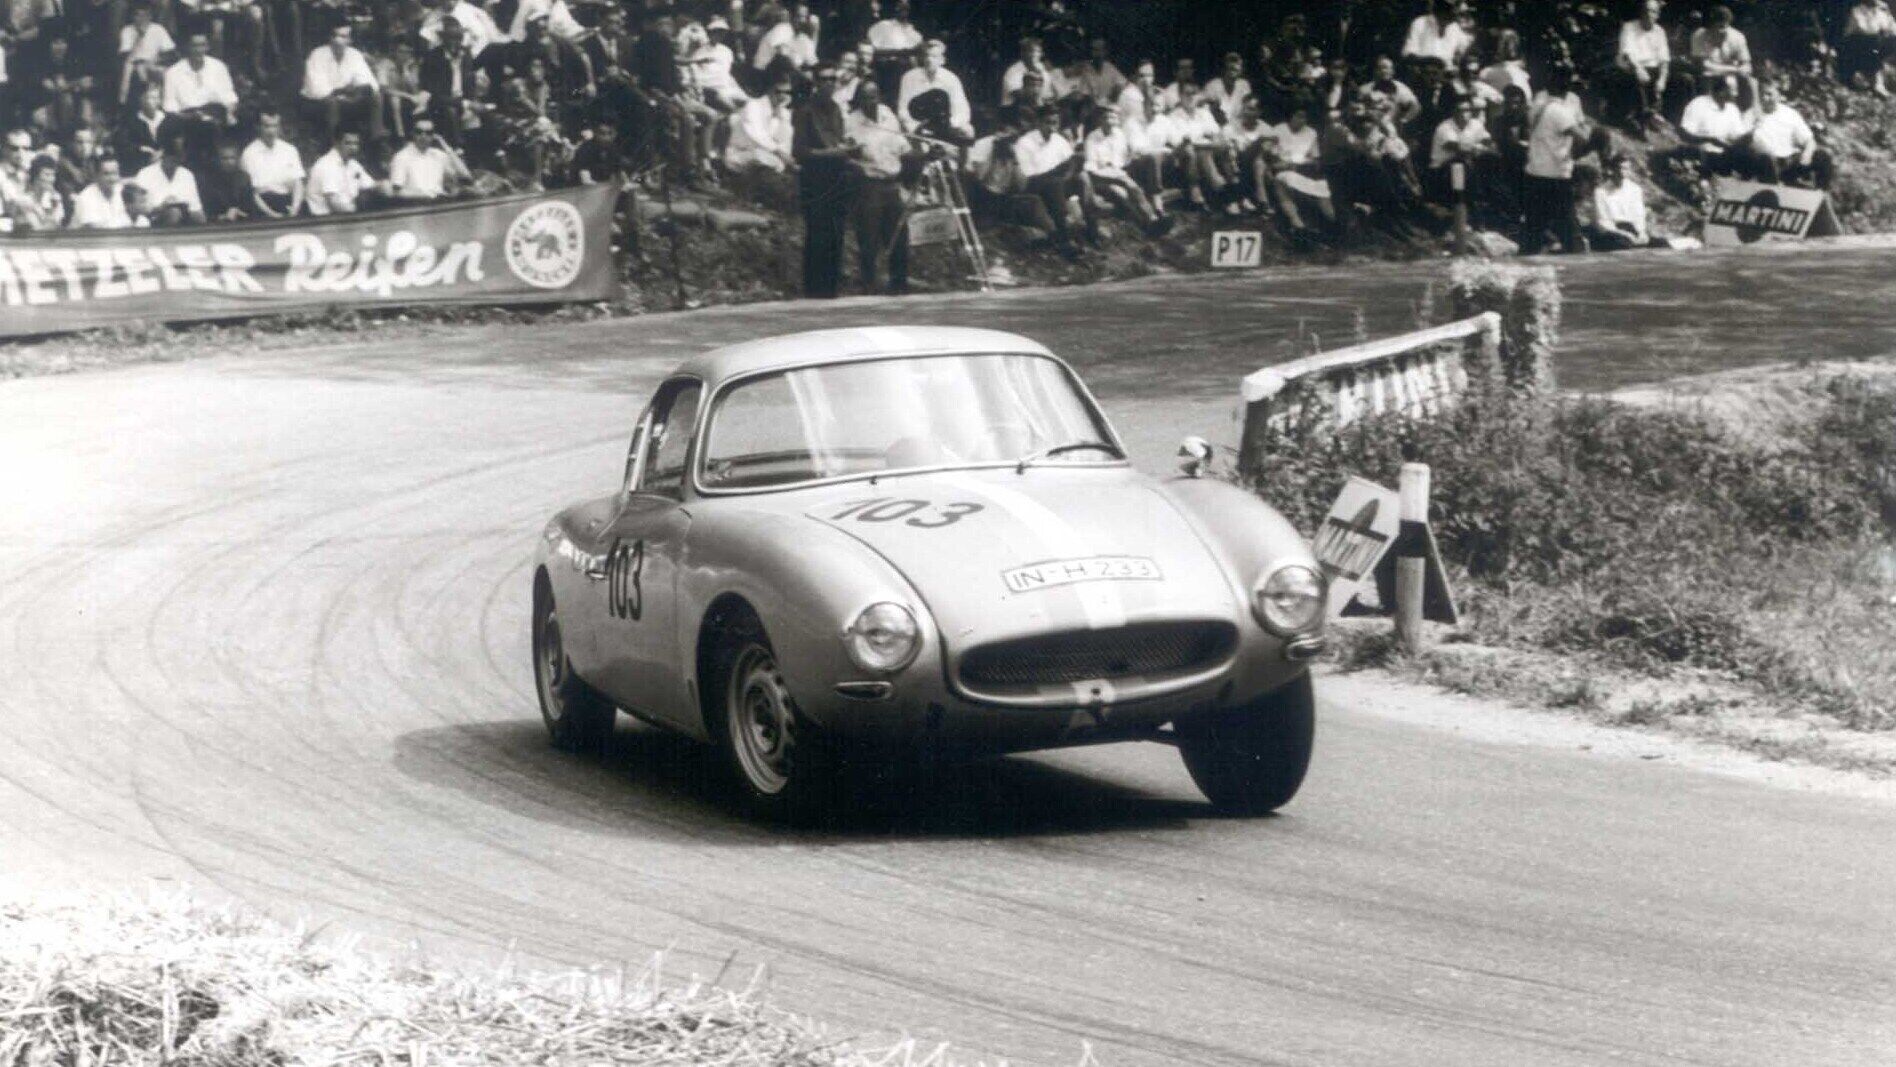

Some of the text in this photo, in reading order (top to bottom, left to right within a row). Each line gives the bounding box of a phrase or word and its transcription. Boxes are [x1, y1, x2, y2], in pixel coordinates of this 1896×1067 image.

[1711, 201, 1807, 233] MARTINI
[274, 230, 484, 297] Reifen
[831, 497, 985, 529] 103
[605, 536, 644, 621] 103
